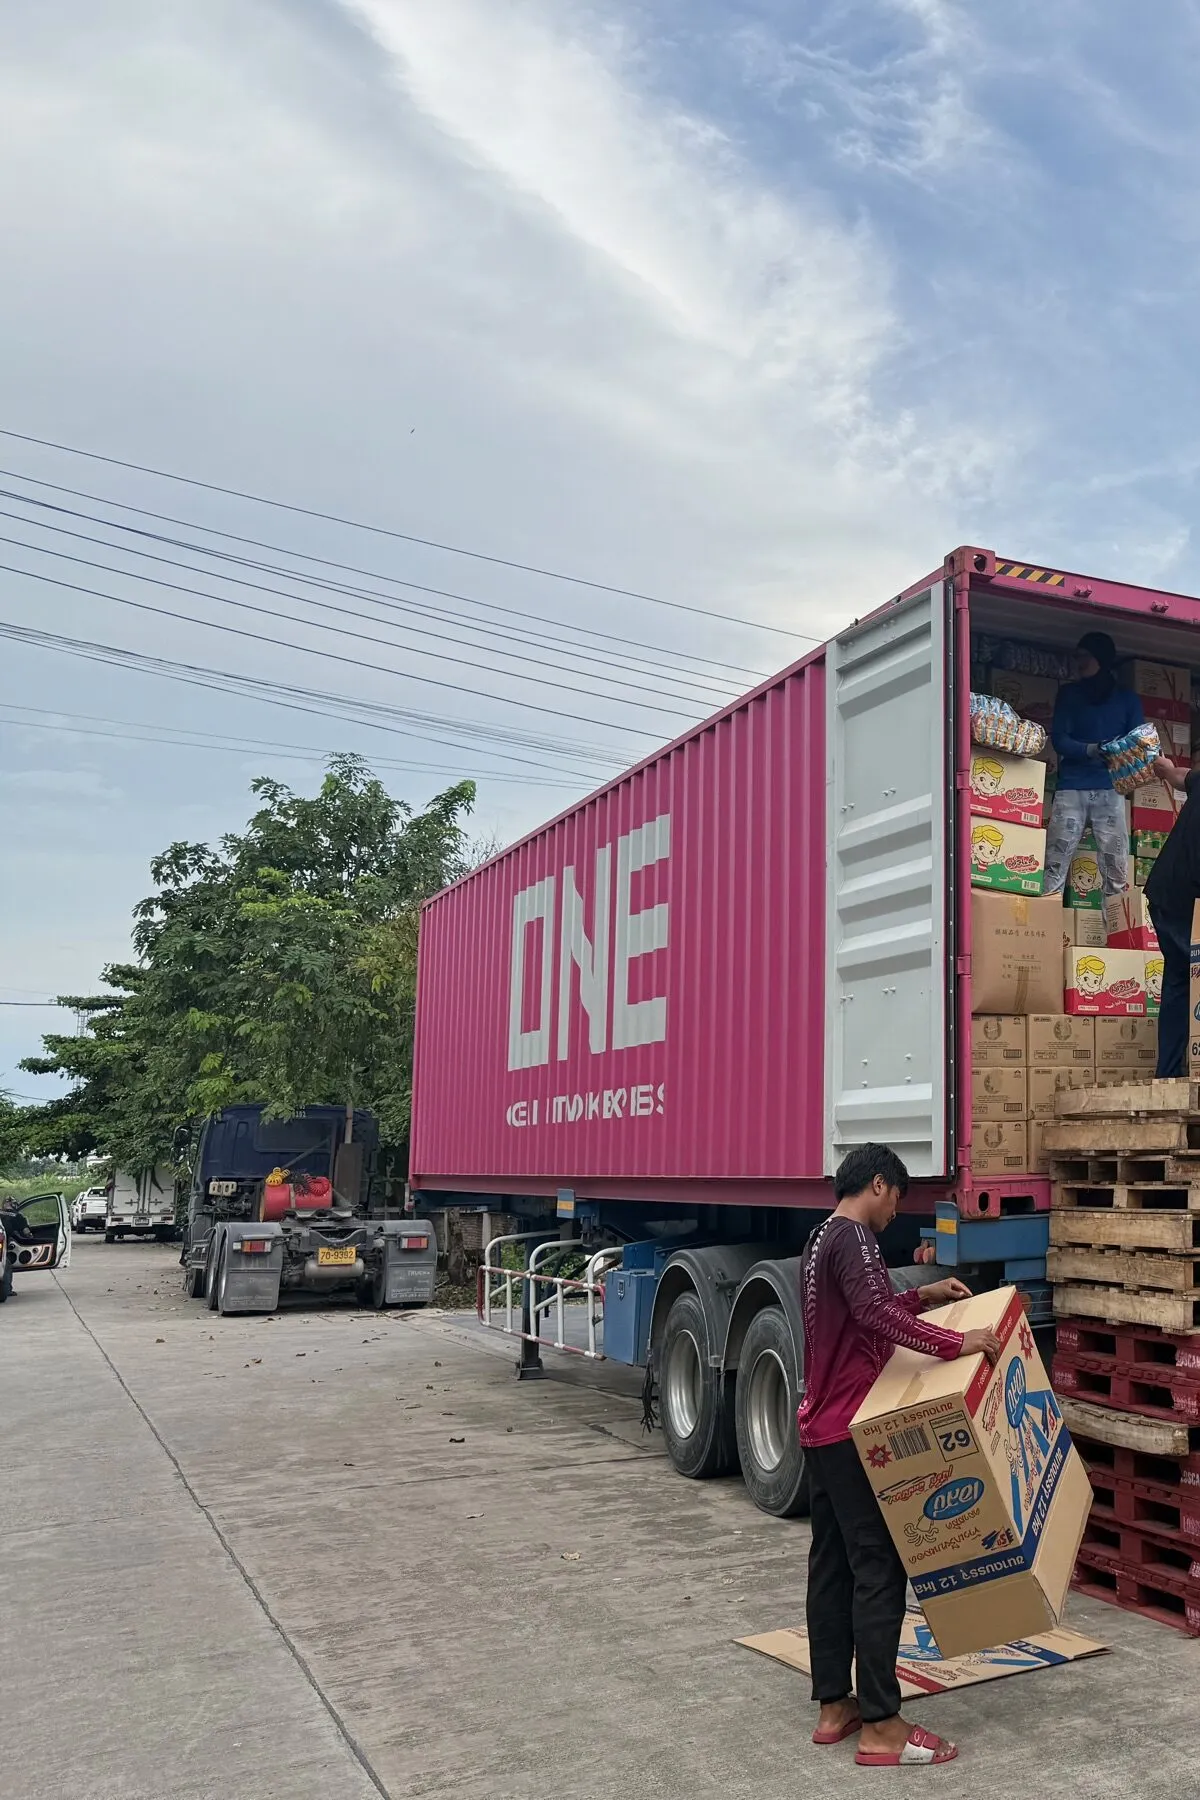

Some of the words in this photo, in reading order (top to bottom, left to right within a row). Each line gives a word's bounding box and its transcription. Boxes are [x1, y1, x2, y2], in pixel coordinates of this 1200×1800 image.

[508, 813, 670, 1072] ONE
[860, 1246, 872, 1264] RUN
[884, 1304, 914, 1326] HEALTH
[904, 1402, 954, 1424] ขนาดบรรจุ
[864, 1425, 882, 1436] โหล
[884, 1421, 900, 1430] 12
[939, 1429, 970, 1452] 62
[1038, 1496, 1048, 1518] 12
[914, 1581, 936, 1594] โหล
[938, 1575, 958, 1588] 12
